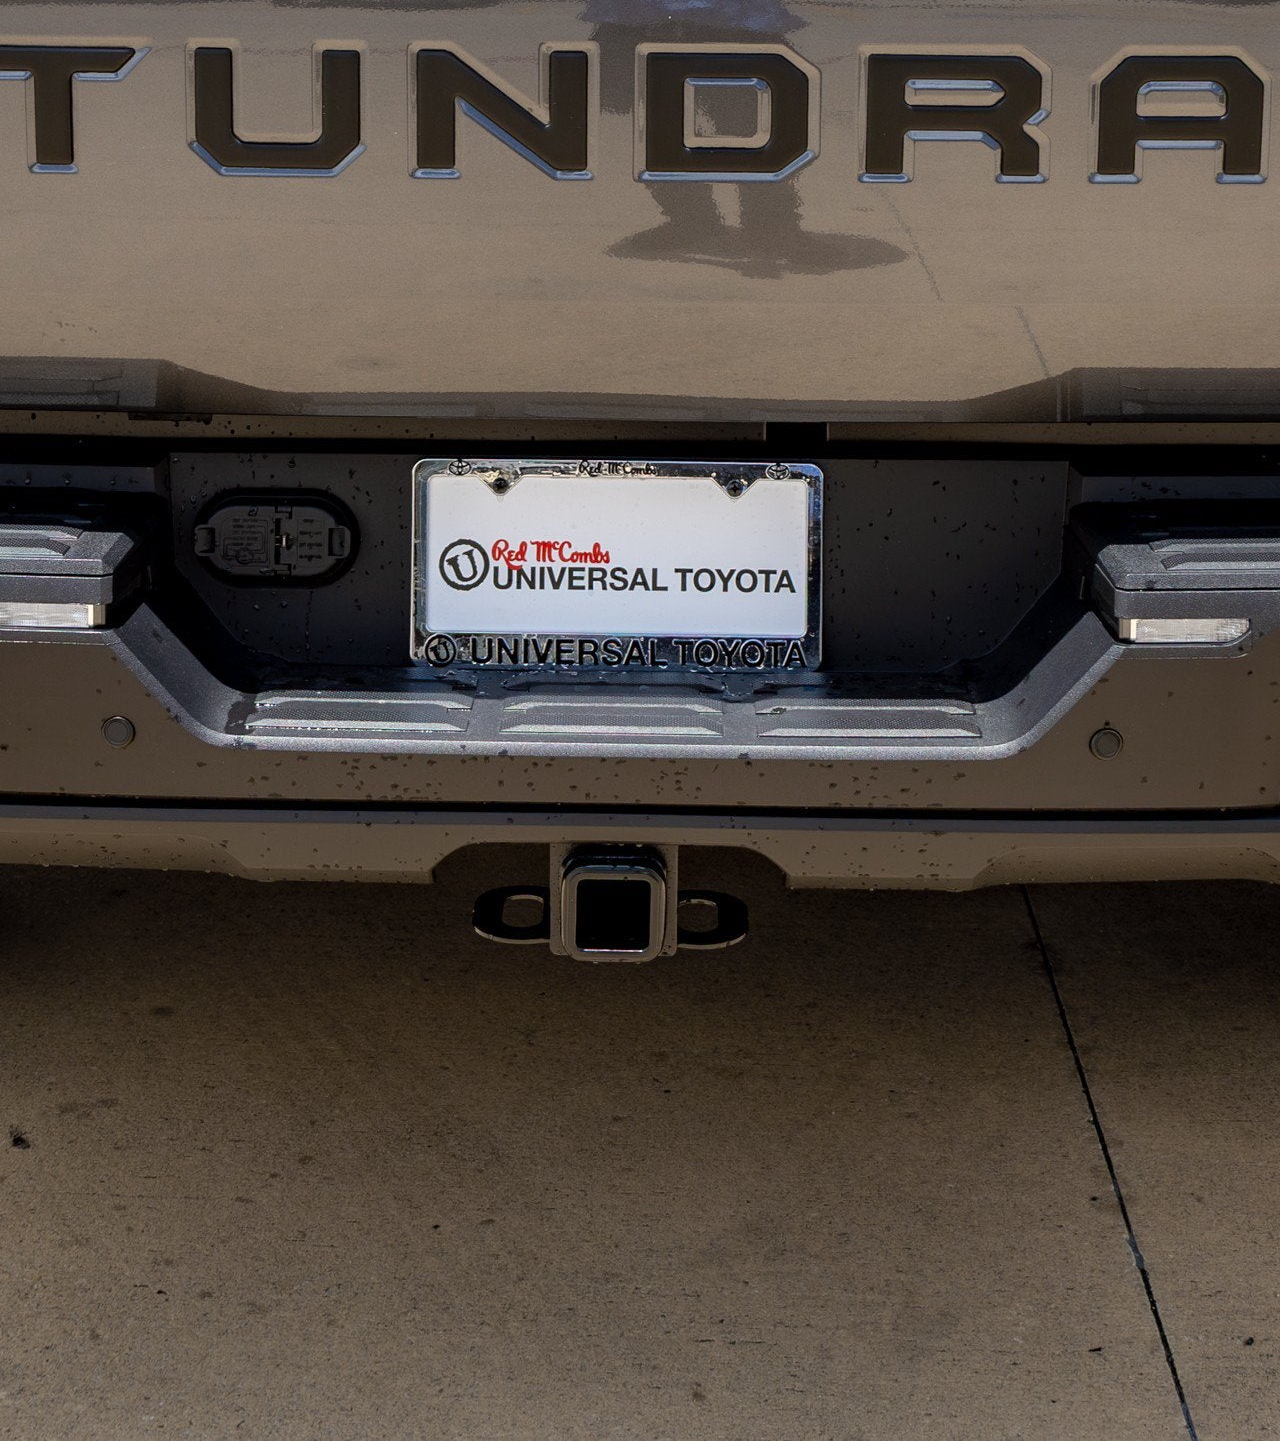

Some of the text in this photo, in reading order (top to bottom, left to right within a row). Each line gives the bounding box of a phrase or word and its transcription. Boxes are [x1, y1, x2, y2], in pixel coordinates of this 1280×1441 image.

[491, 539, 610, 571] Red McCombs
[493, 566, 797, 593] UNIVERSAL TOYOTA
[471, 637, 669, 668] UNIVERSAL
[673, 638, 808, 668] TOYOTA
